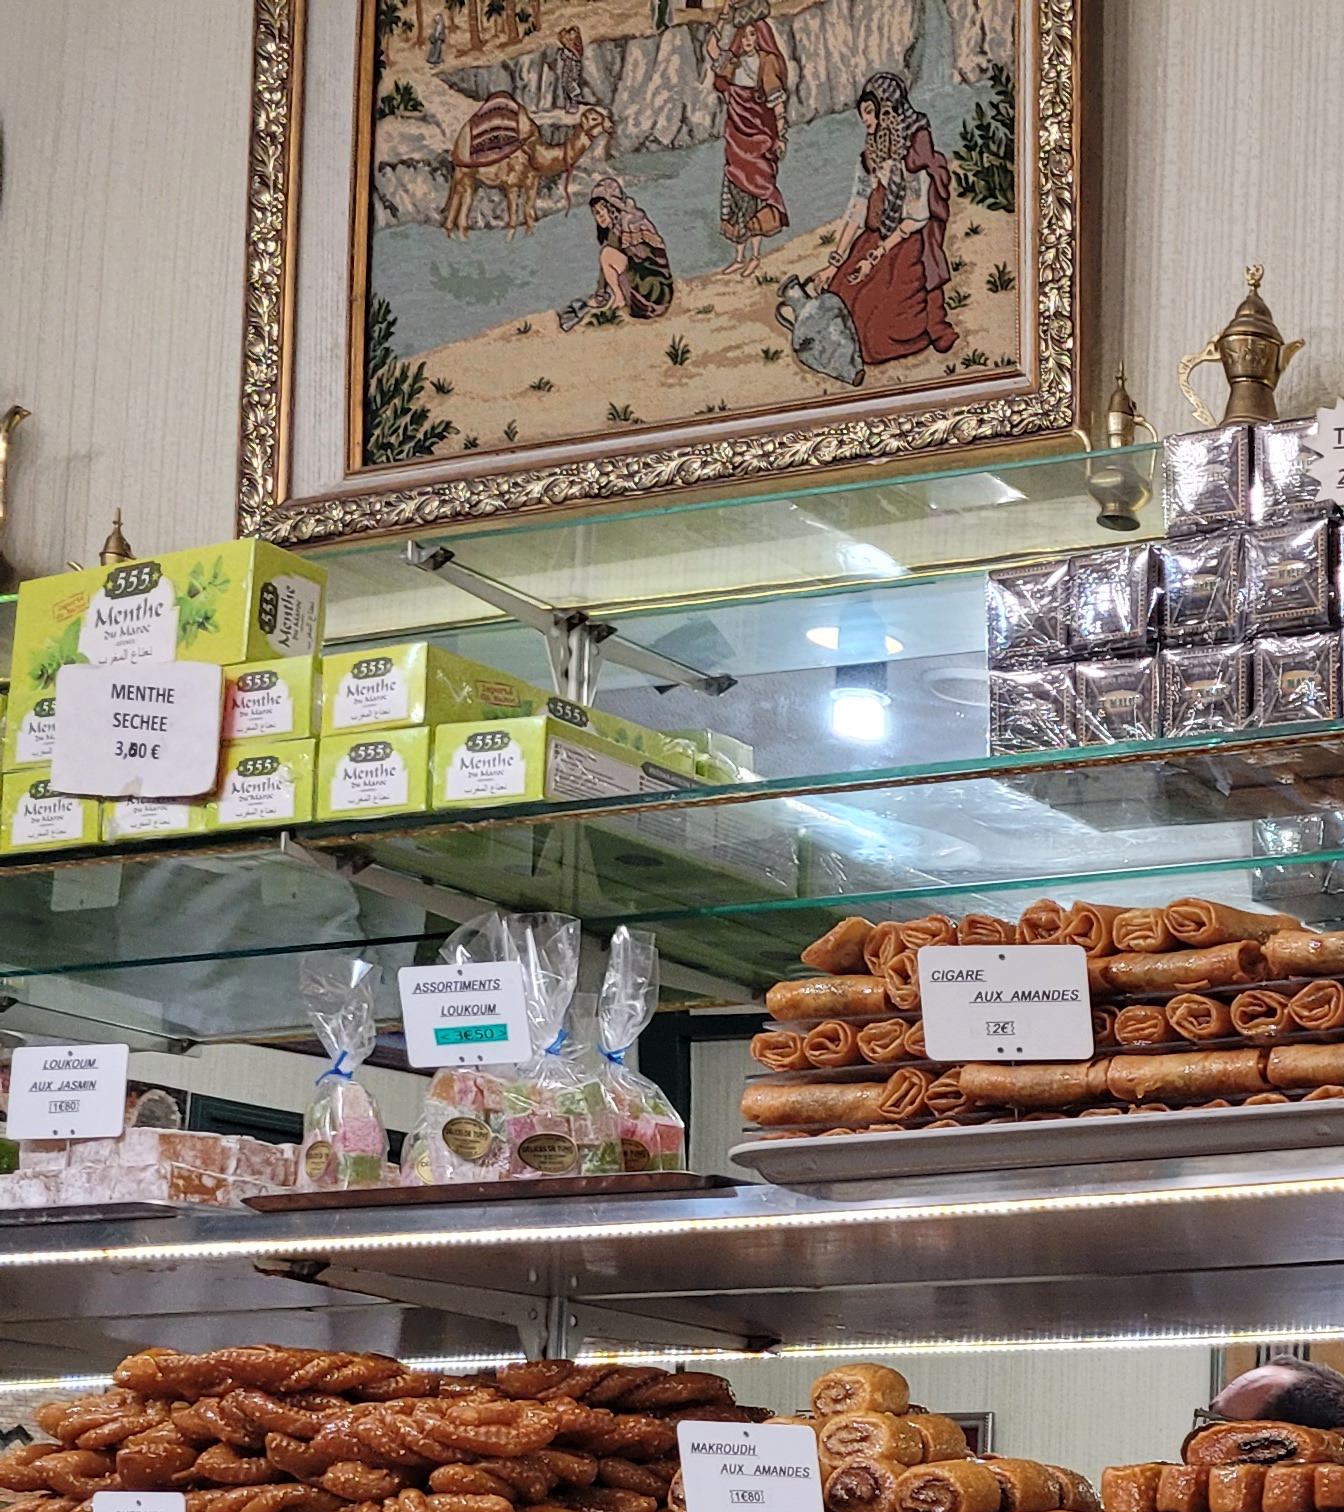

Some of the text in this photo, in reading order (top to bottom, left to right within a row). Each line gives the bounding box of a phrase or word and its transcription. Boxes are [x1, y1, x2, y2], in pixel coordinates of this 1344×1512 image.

[115, 567, 150, 595] 555
[95, 597, 164, 629] Menthe
[261, 591, 277, 628] 555
[359, 660, 385, 677] 555
[245, 673, 271, 689] 555
[346, 679, 397, 698] Menthe
[111, 683, 175, 705] MENTHE
[232, 692, 283, 710] Menthe
[556, 701, 581, 723] 555
[113, 712, 169, 732] SECHEE
[475, 734, 502, 750] 555
[357, 744, 384, 761] 555
[246, 759, 272, 775] 555
[460, 753, 514, 771] Menthe
[343, 763, 397, 781] Menthe
[231, 777, 283, 795] Menthe
[24, 799, 73, 817] Menthe
[931, 969, 985, 982] CIGARE
[413, 978, 501, 994] ASSORTIMENTS
[974, 989, 1080, 1003] AUX AMANDES
[440, 1003, 497, 1017] LOUKOUM
[992, 1022, 1010, 1034] 2€
[42, 1058, 97, 1071] LOUKOUM
[29, 1080, 97, 1092] AUX JASMIN
[690, 1442, 757, 1456] MAKROUDH
[720, 1463, 811, 1478] AUX AMANDES
[735, 1491, 761, 1503] 1€80
